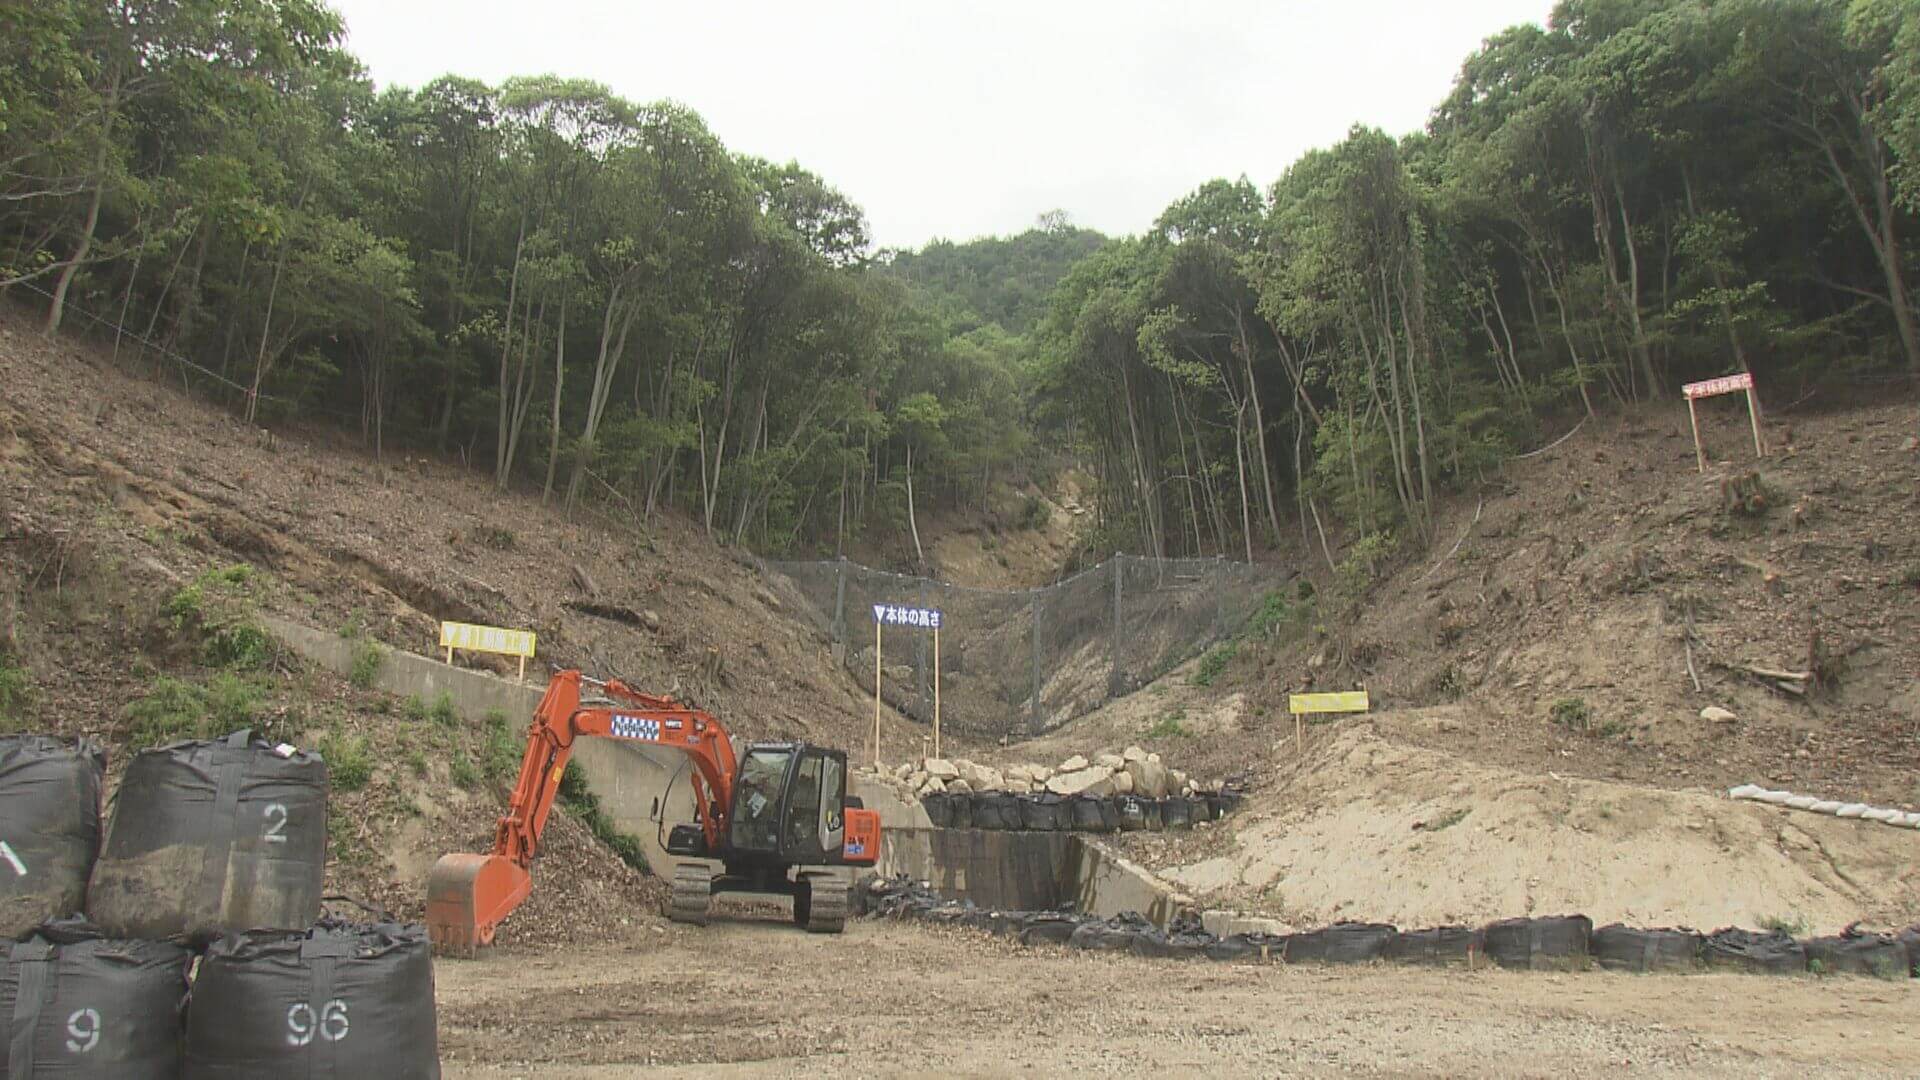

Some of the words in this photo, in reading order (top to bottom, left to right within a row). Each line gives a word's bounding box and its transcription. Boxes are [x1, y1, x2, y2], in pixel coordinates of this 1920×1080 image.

[263, 804, 288, 843] 2
[66, 1008, 101, 1053] 9
[286, 1000, 350, 1047] 96
